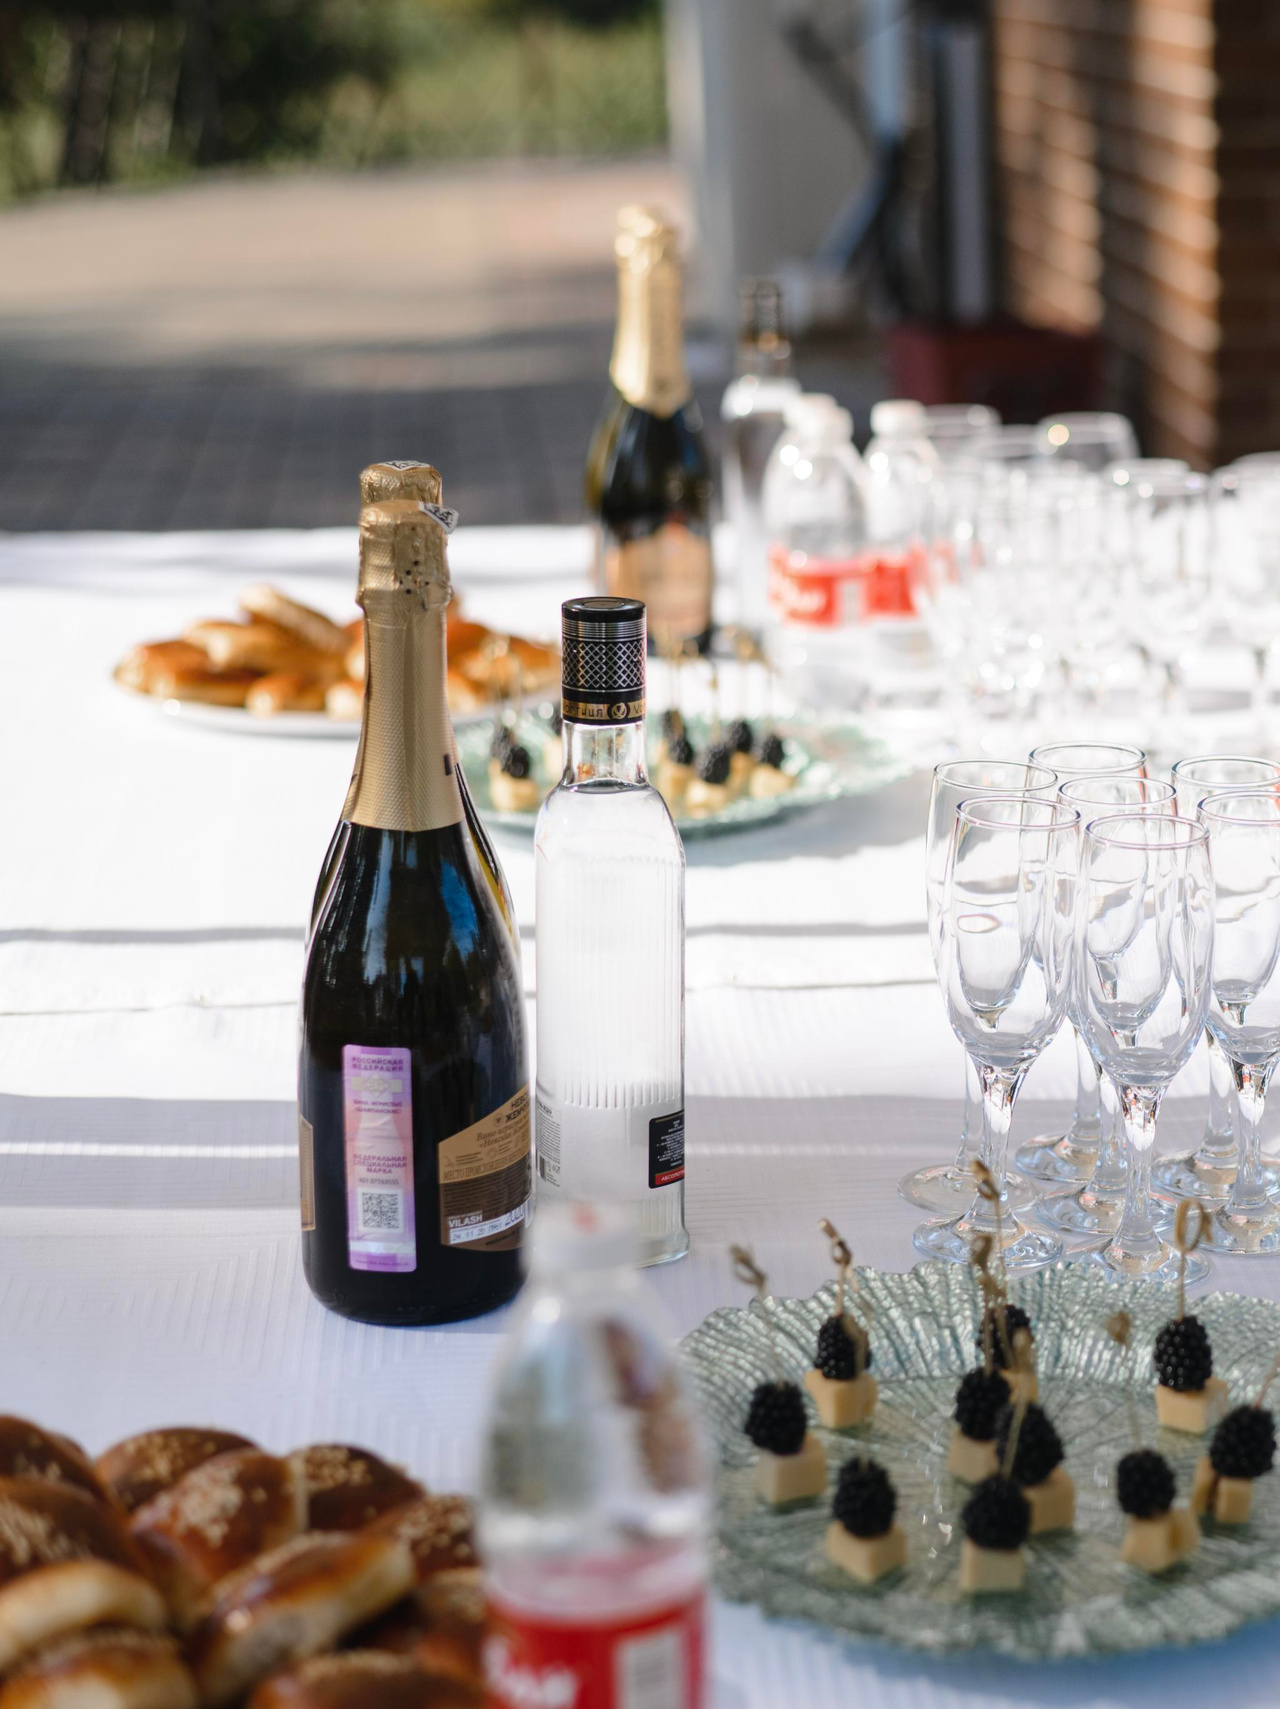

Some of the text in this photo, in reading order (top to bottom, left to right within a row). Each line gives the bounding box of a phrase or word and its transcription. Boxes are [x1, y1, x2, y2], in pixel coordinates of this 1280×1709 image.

[352, 1056, 404, 1065] РОССИЙСКАЯ
[352, 1063, 404, 1072] ФЕДЕРАЦИЯ
[352, 1153, 408, 1162] ФЕДЕРАЛЬНАЯ
[352, 1160, 408, 1168] СПЕЦИАЛЬНАЯ
[448, 1215, 483, 1228] VILASH
